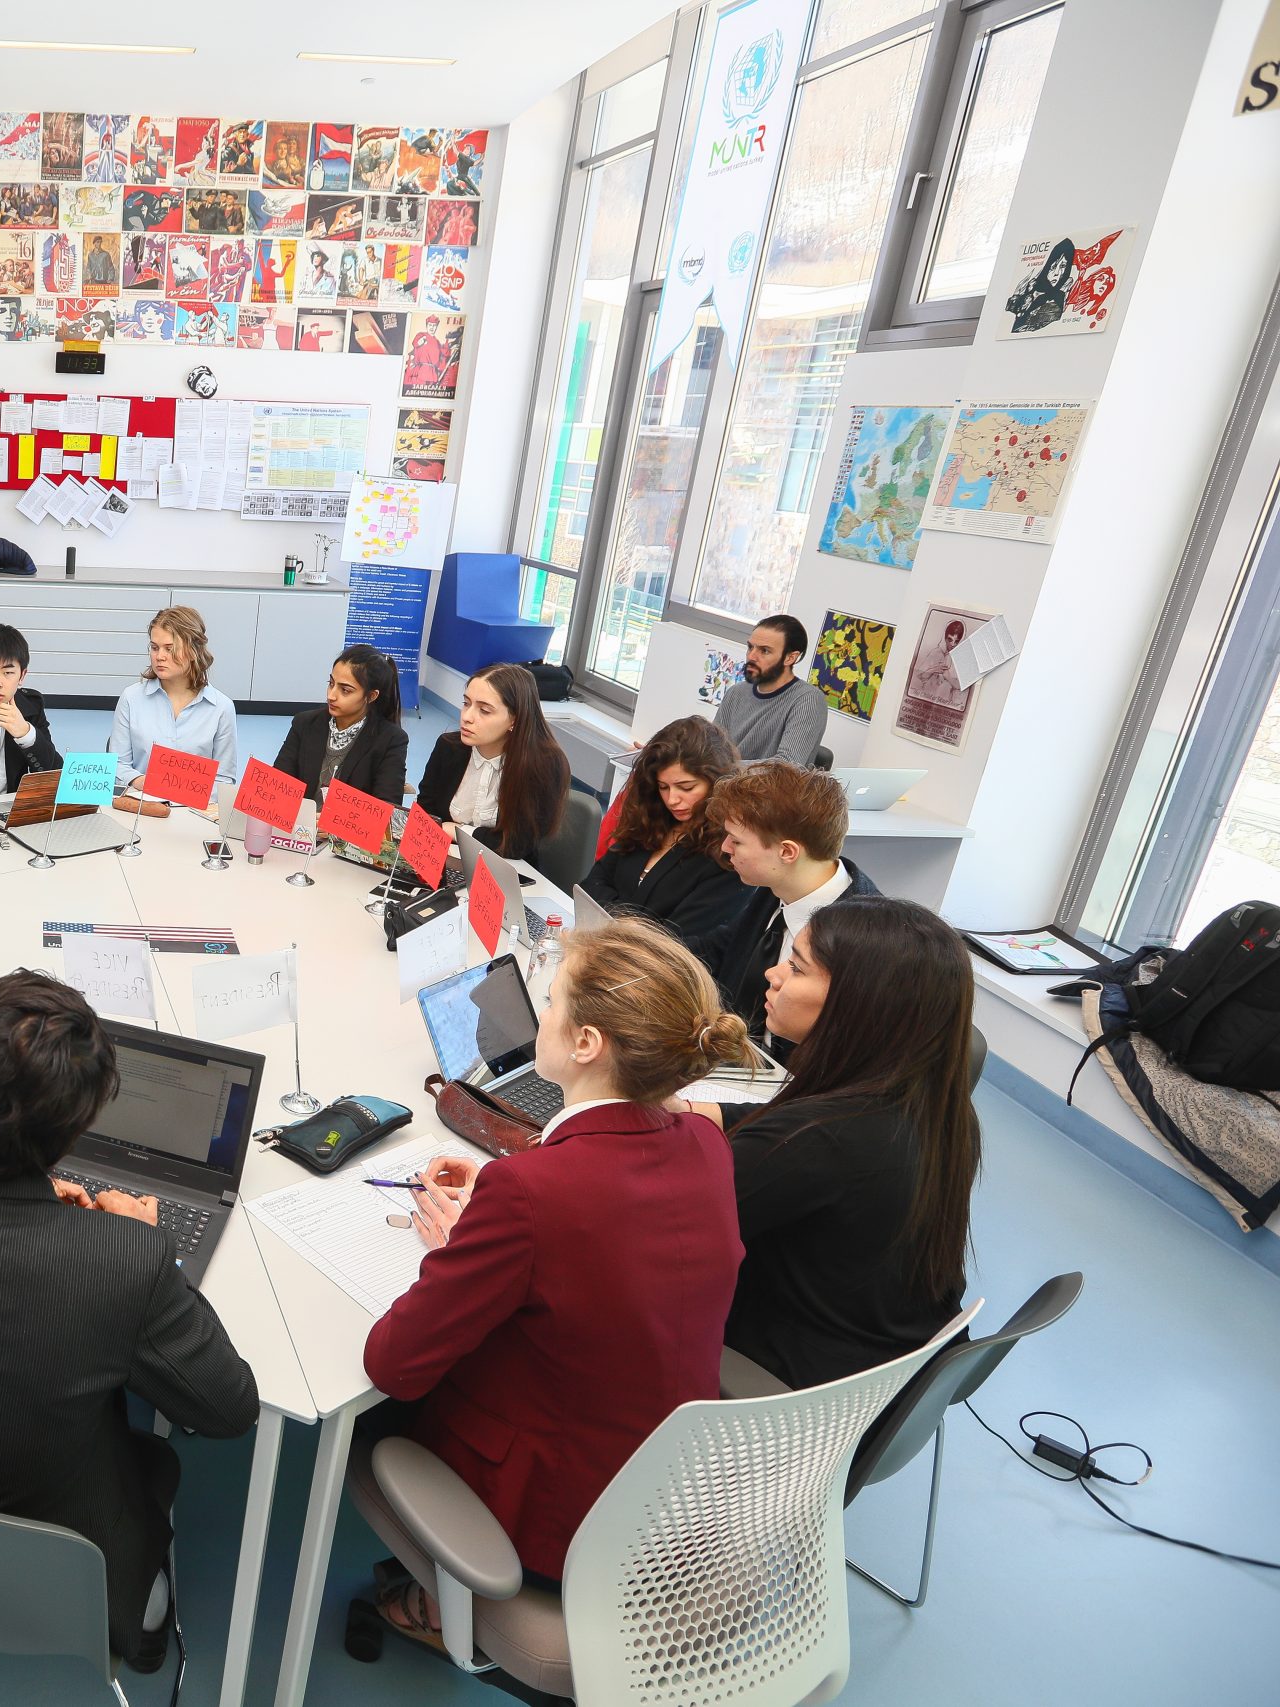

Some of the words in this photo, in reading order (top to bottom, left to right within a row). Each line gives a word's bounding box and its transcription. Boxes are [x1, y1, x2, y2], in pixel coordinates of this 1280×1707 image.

[709, 125, 766, 168] MUNTR
[1023, 242, 1050, 255] LIDICE
[440, 277, 463, 289] SNP
[68, 760, 112, 776] GENERAL
[158, 753, 211, 777] GENERAL
[71, 777, 112, 794] ADVISOR
[161, 772, 209, 797] ADVISOR
[250, 768, 304, 801] PERMANENT
[334, 787, 386, 819] SECRETARY
[266, 810, 293, 831] NATIONS
[348, 810, 360, 821] OF
[332, 814, 370, 840] ENERGY
[409, 854, 425, 871] STAFF
